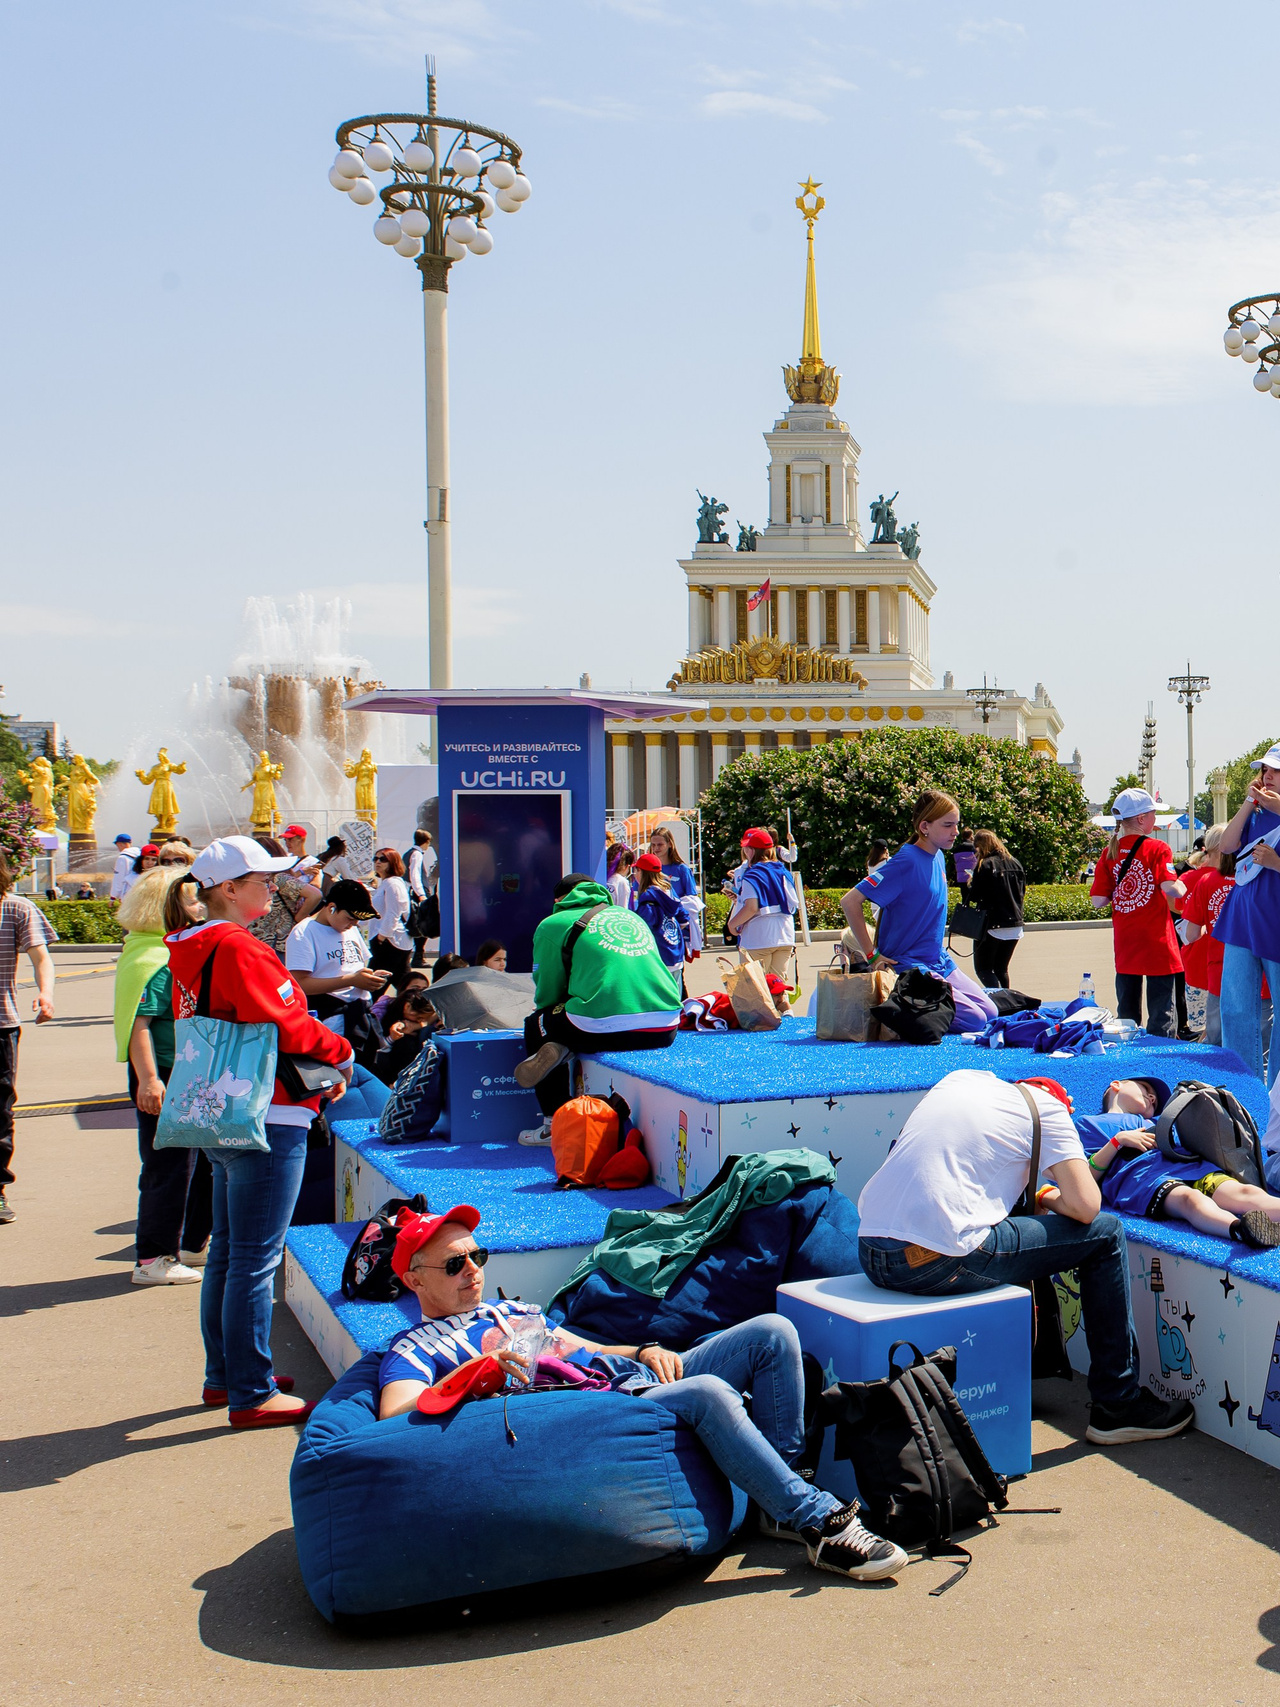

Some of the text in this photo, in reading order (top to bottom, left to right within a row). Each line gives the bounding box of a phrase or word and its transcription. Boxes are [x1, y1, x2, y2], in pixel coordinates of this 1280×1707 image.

[445, 741, 581, 752] УЧИТЕСЬ И РАЗВИВАЙТЕСЬ
[488, 755, 538, 763] ВМЕСТЕ С
[461, 770, 566, 788] UCHi.RU
[598, 939, 649, 957] ПЕРВЫМ
[493, 1075, 518, 1085] сфер
[495, 1088, 536, 1096] Мессендже
[1164, 1299, 1181, 1315] ТЫ
[952, 1382, 997, 1401] ерум
[1149, 1373, 1207, 1400] СПРАВИШЬСЯ
[966, 1405, 1010, 1421] сенджер
